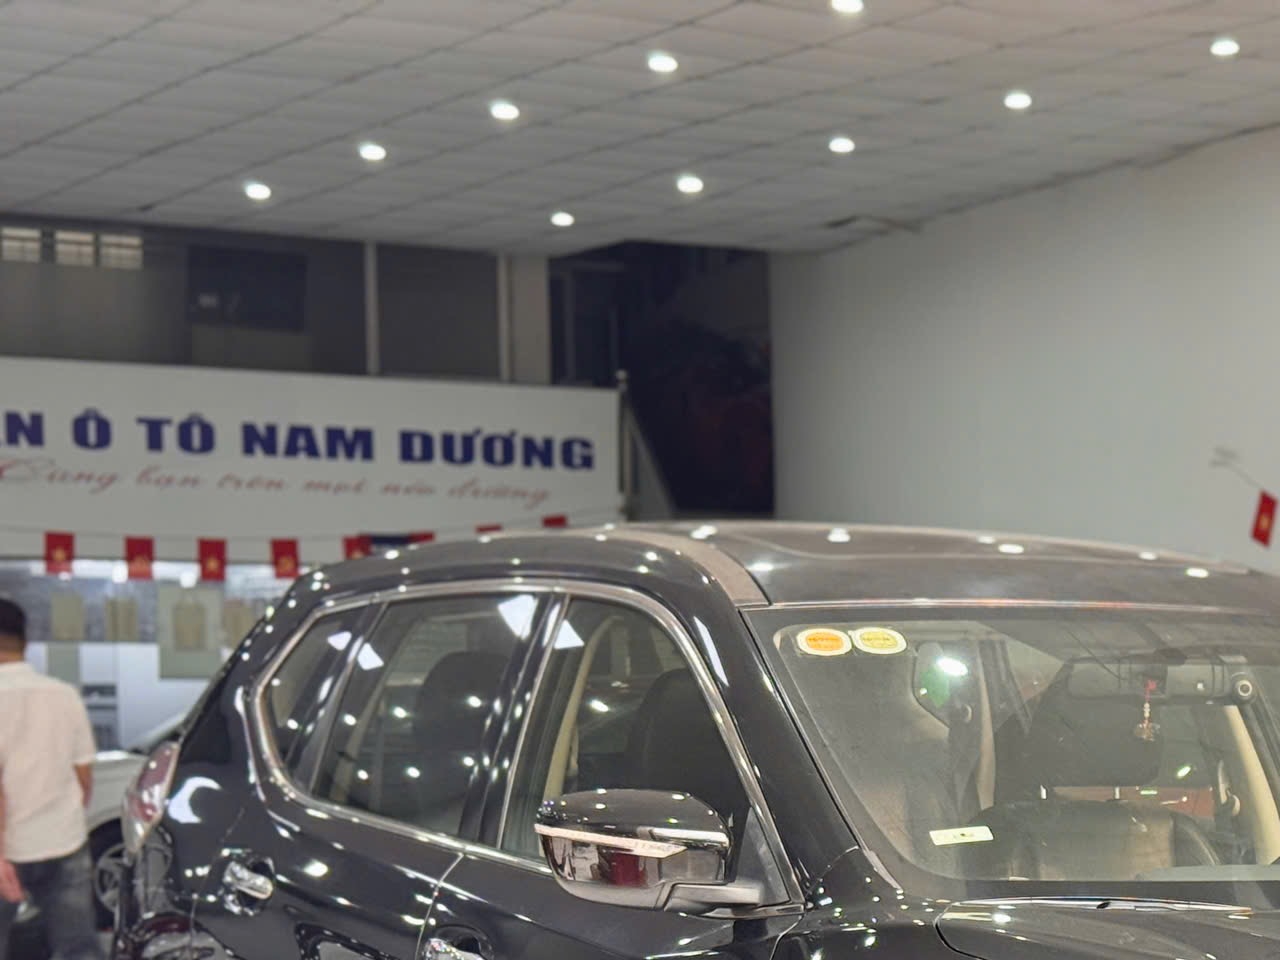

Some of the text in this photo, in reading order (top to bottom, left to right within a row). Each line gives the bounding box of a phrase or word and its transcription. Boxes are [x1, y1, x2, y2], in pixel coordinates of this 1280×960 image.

[0, 407, 595, 470] N Ô TÔ NAM DƯƠNG
